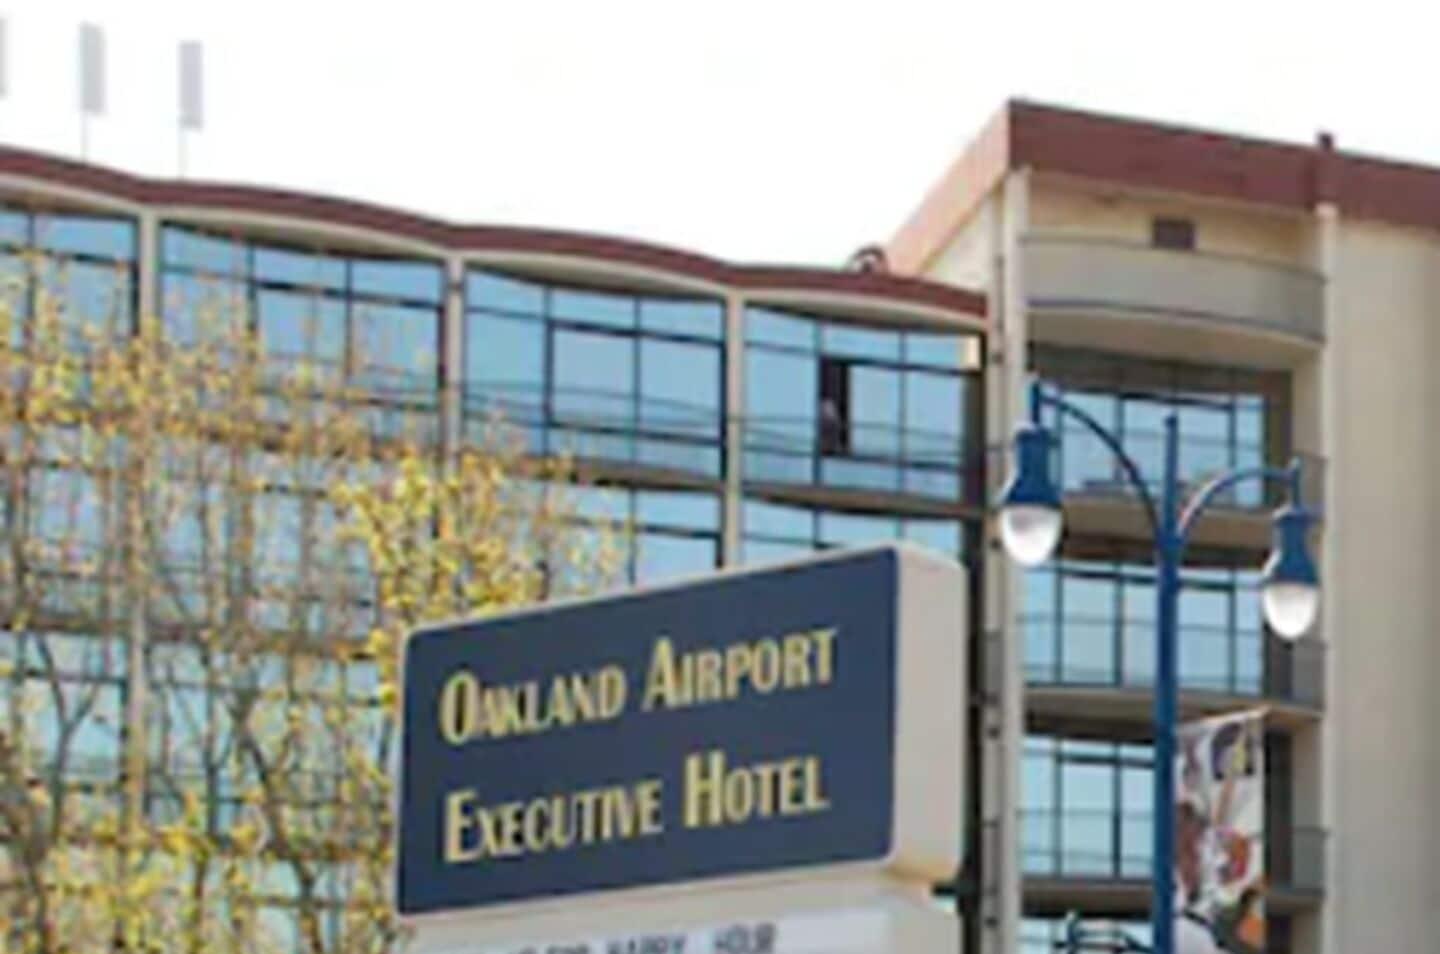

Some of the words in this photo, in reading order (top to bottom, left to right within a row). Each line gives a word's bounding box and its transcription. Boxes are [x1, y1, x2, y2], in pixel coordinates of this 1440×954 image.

[439, 666, 627, 745] OAKLAND
[642, 628, 837, 711] AIRPORT
[443, 780, 664, 864] EXECUTIVE
[682, 749, 830, 828] HOTEL
